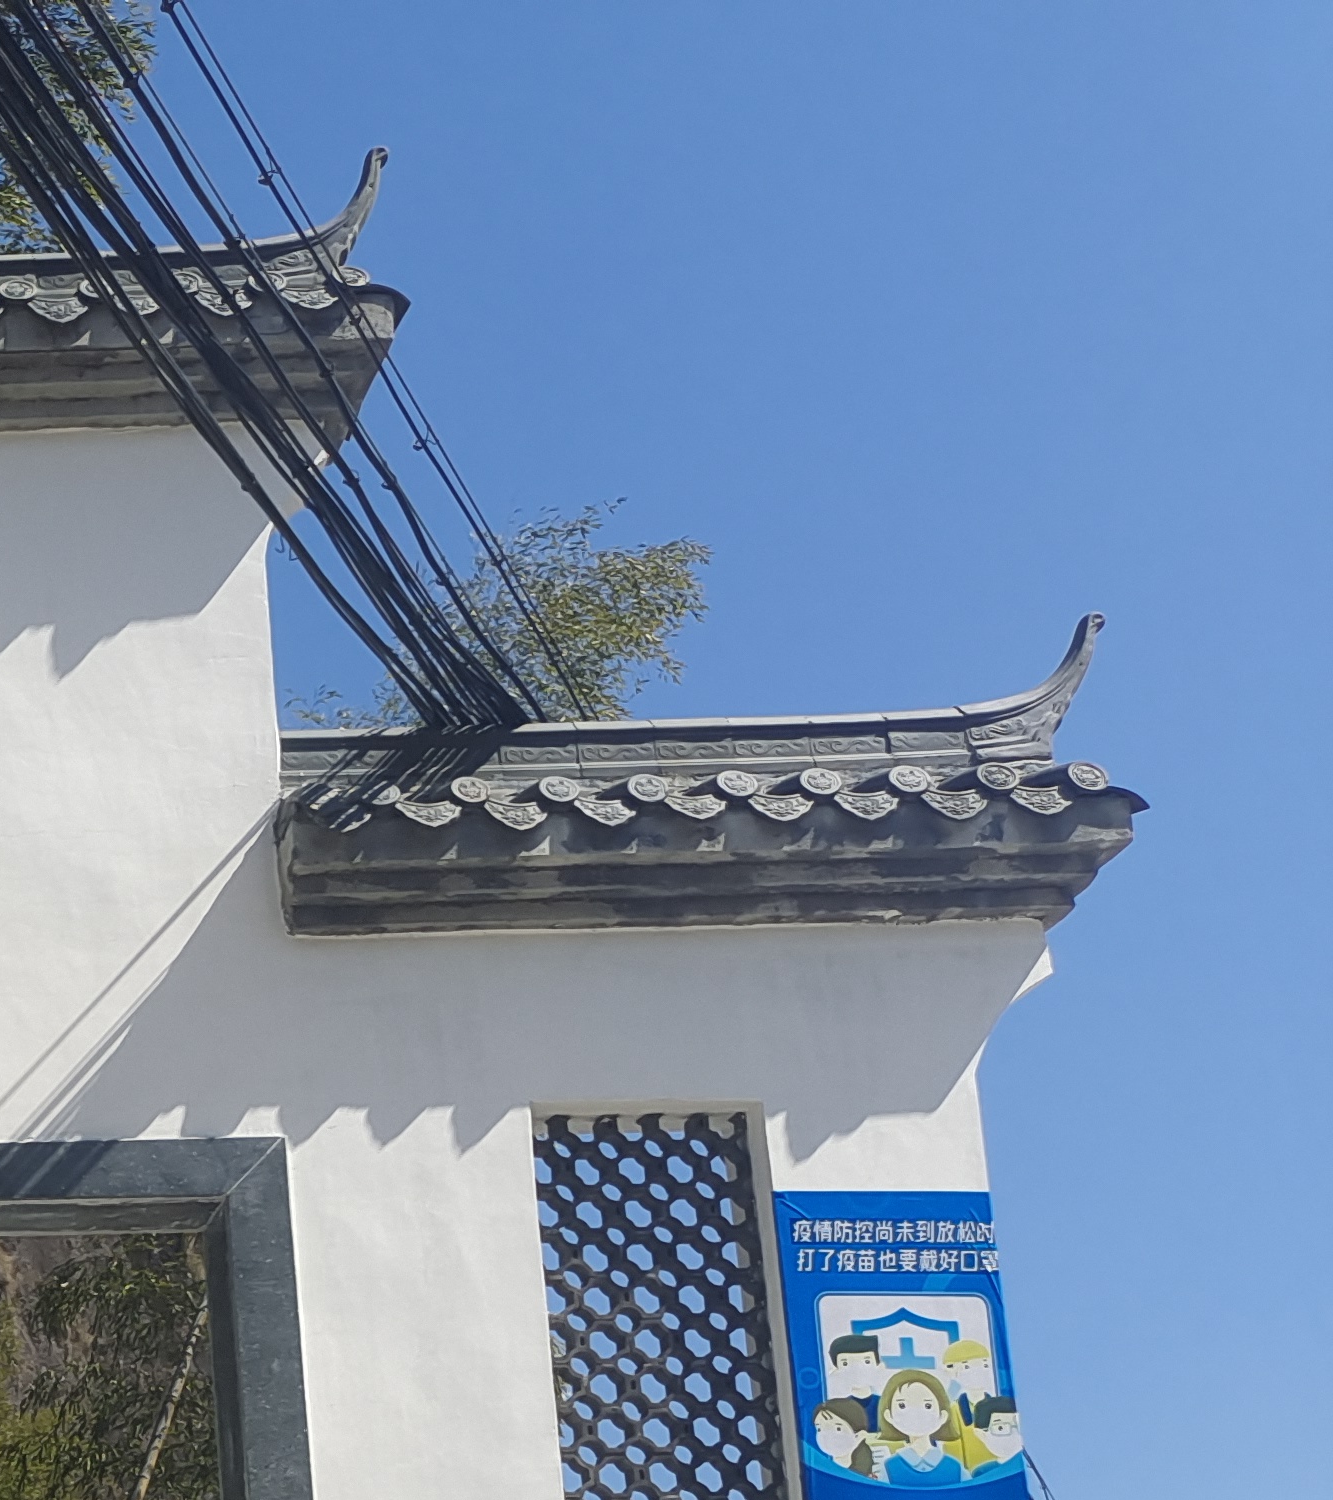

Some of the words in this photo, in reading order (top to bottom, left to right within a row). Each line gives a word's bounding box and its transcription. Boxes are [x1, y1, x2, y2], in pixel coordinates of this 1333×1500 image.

[793, 1219, 995, 1244] 疫情防控尚未到放松时
[797, 1249, 1000, 1273] 打了疫苗也要戴好口罩
